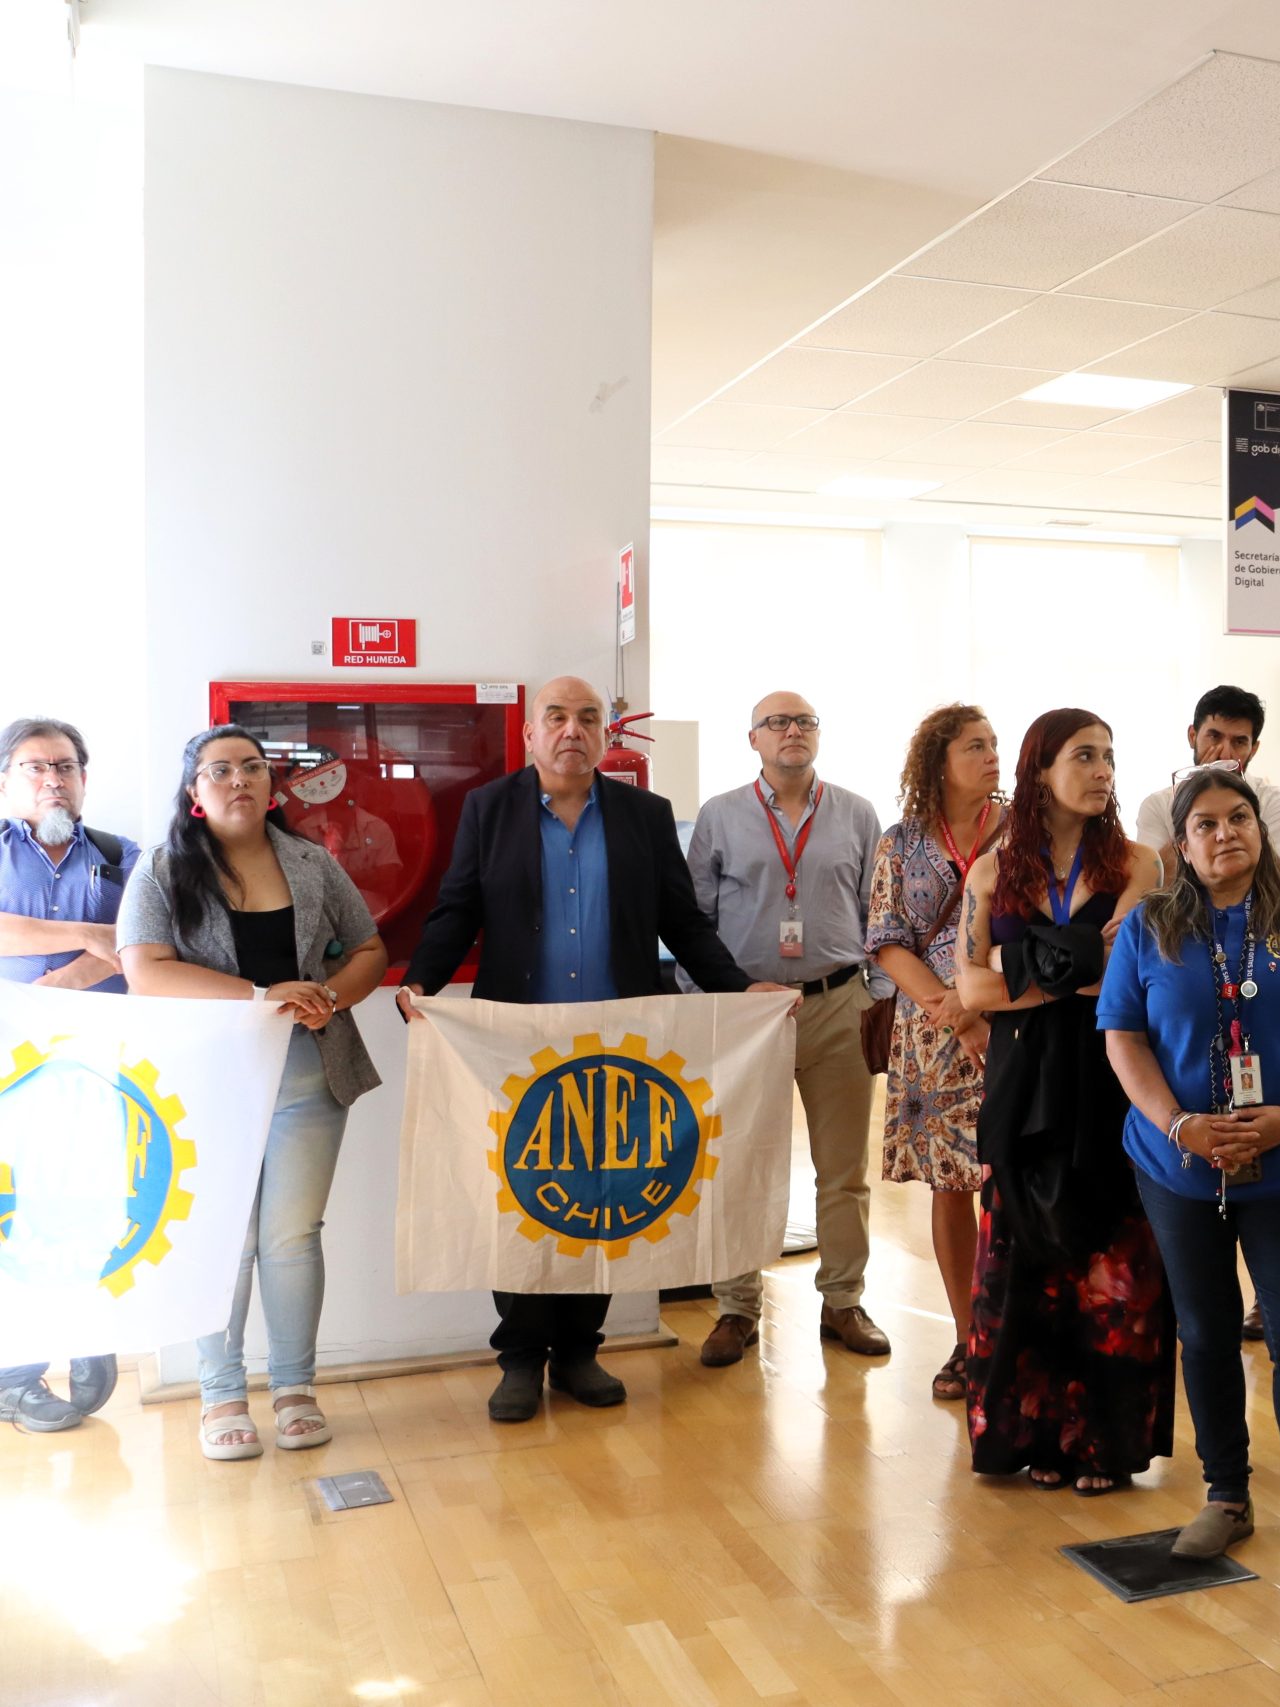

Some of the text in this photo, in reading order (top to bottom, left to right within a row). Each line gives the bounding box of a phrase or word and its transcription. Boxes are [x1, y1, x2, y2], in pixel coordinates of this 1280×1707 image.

[1251, 443, 1270, 456] gob
[1234, 550, 1280, 561] Secretaría
[1234, 564, 1246, 573] de
[1235, 576, 1264, 588] Digital
[344, 655, 407, 664] RED HUMEDA
[1247, 951, 1255, 968] SALUD
[1246, 968, 1253, 977] DE
[512, 1064, 677, 1172] ANEF
[535, 1178, 672, 1230] CHILE
